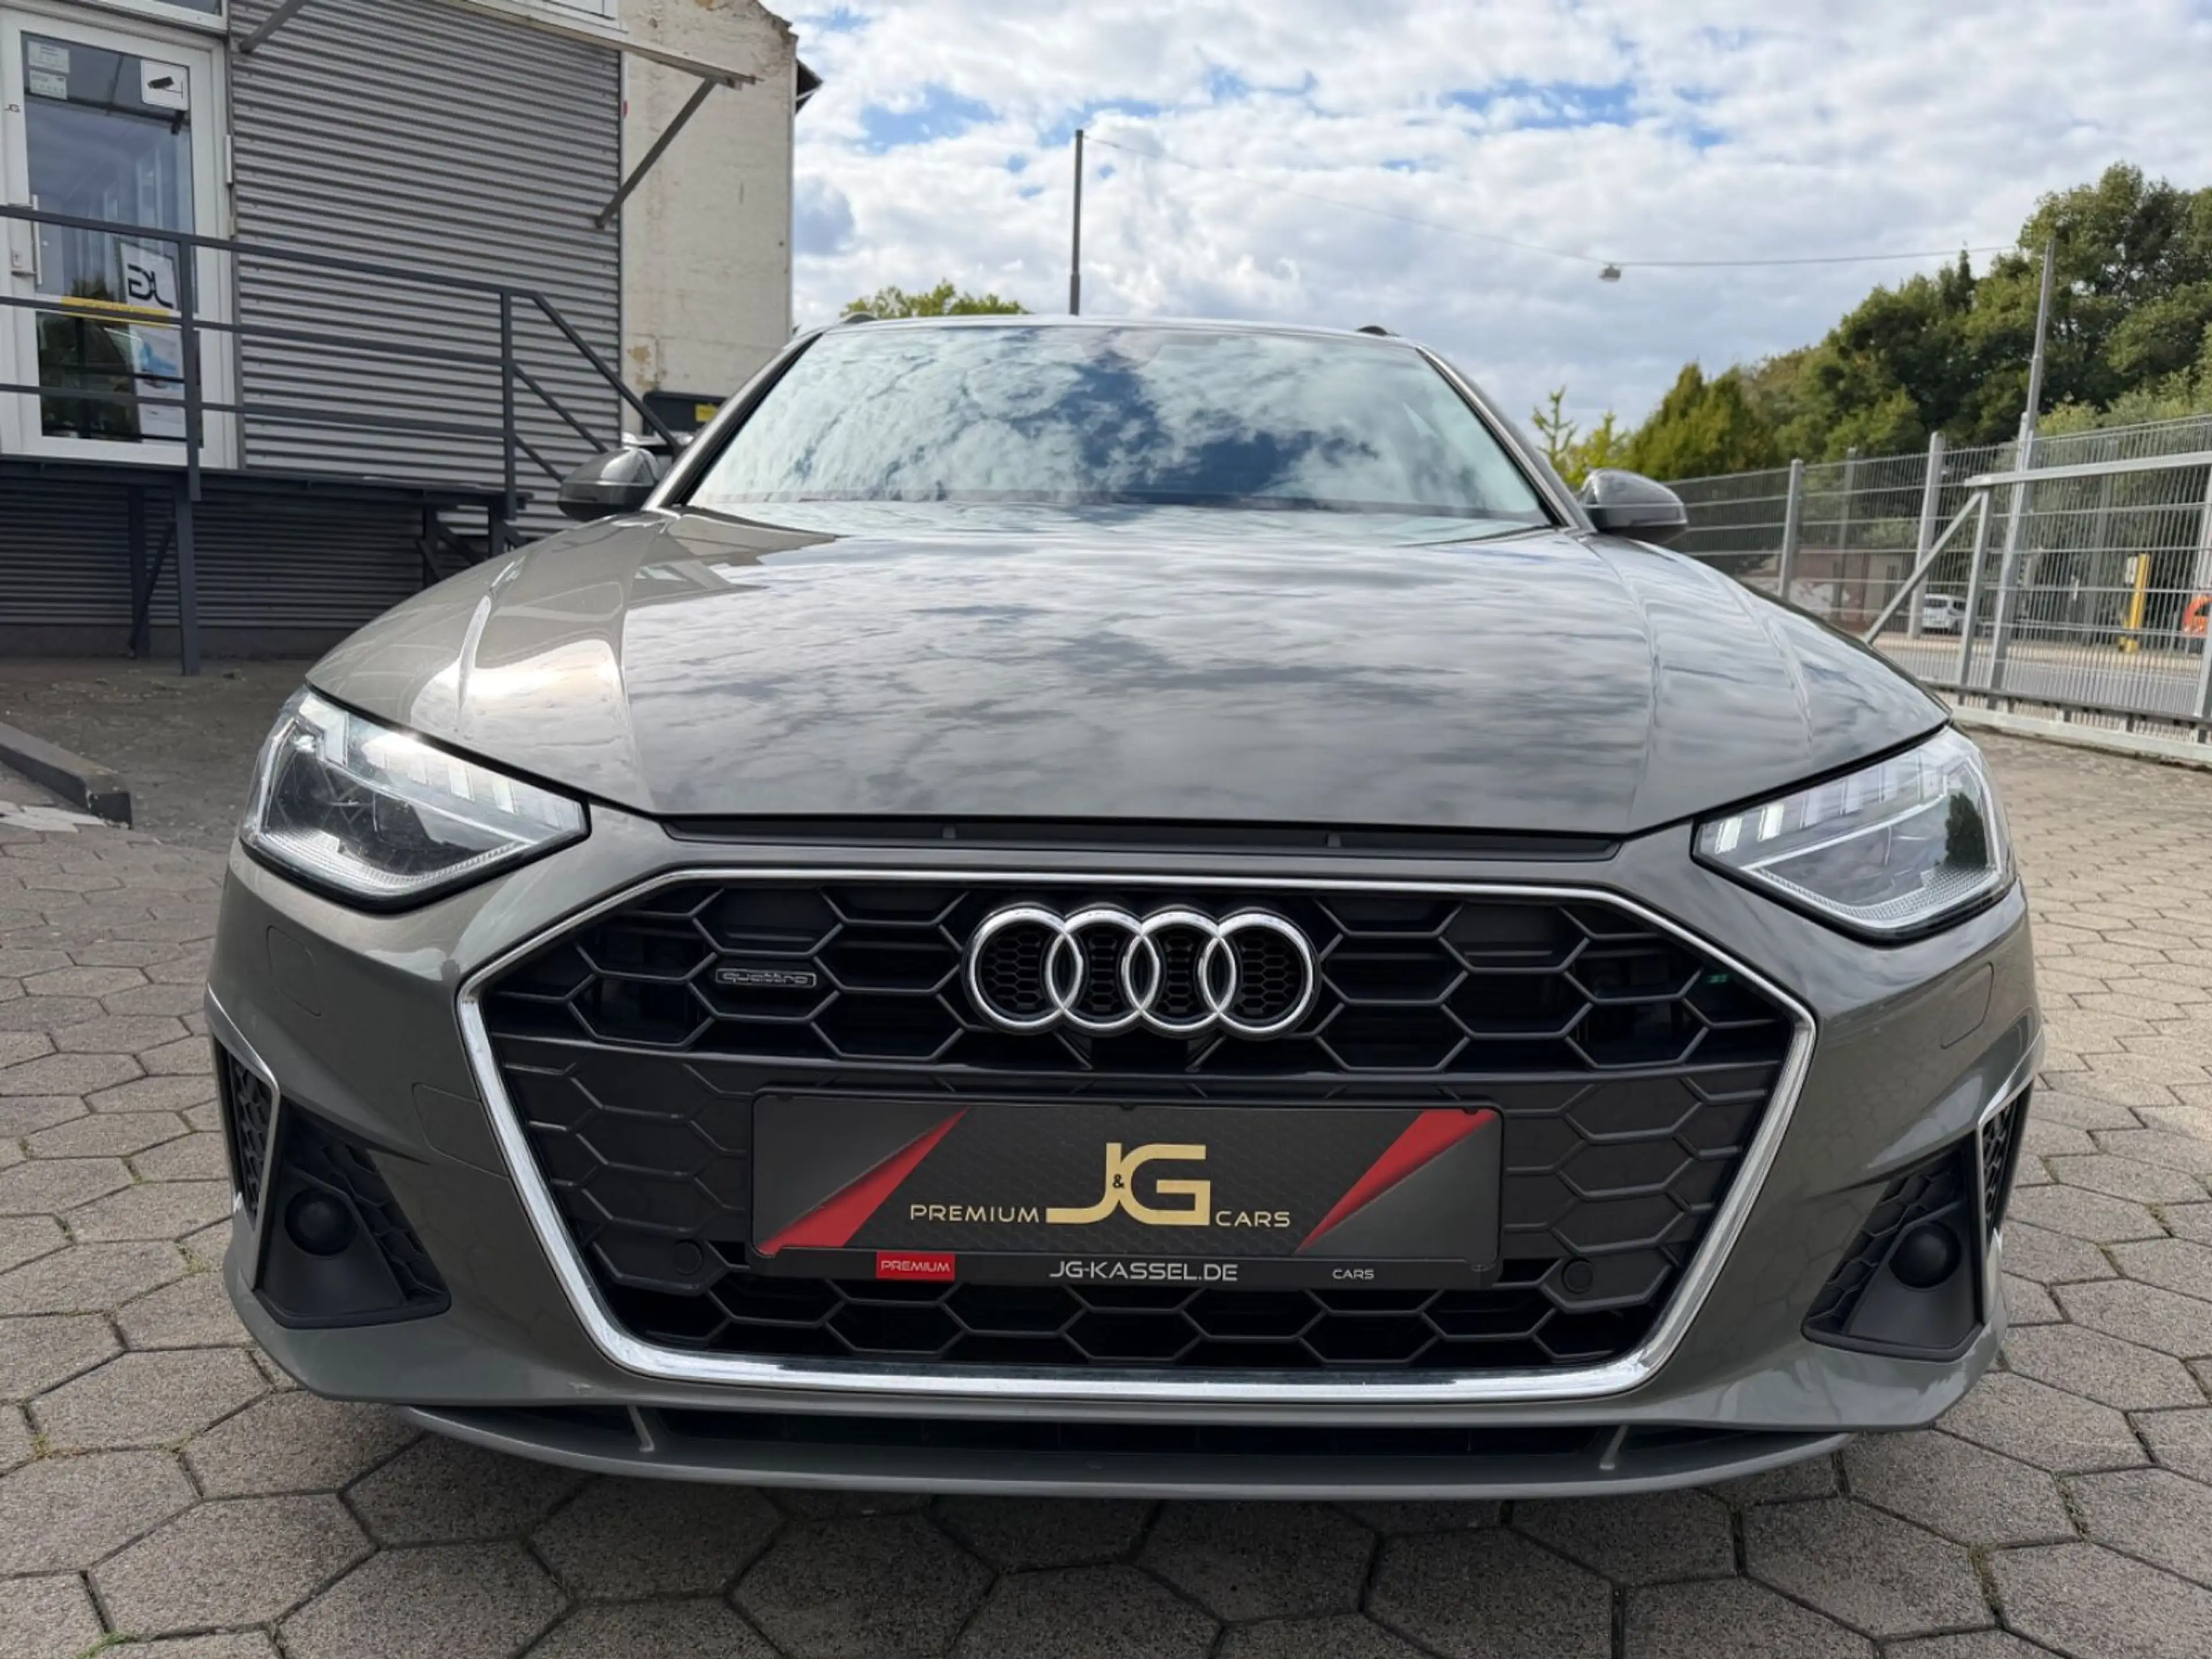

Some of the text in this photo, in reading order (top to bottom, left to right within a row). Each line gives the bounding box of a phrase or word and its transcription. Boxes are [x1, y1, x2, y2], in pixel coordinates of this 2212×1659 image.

[722, 971, 808, 984] quattro
[910, 1204, 1039, 1223] PREMIUM
[1215, 1210, 1290, 1228] CARS
[880, 1260, 950, 1272] PREMIUM
[1050, 1261, 1238, 1281] JG-KASSEL.DE
[1332, 1268, 1375, 1280] CARS
